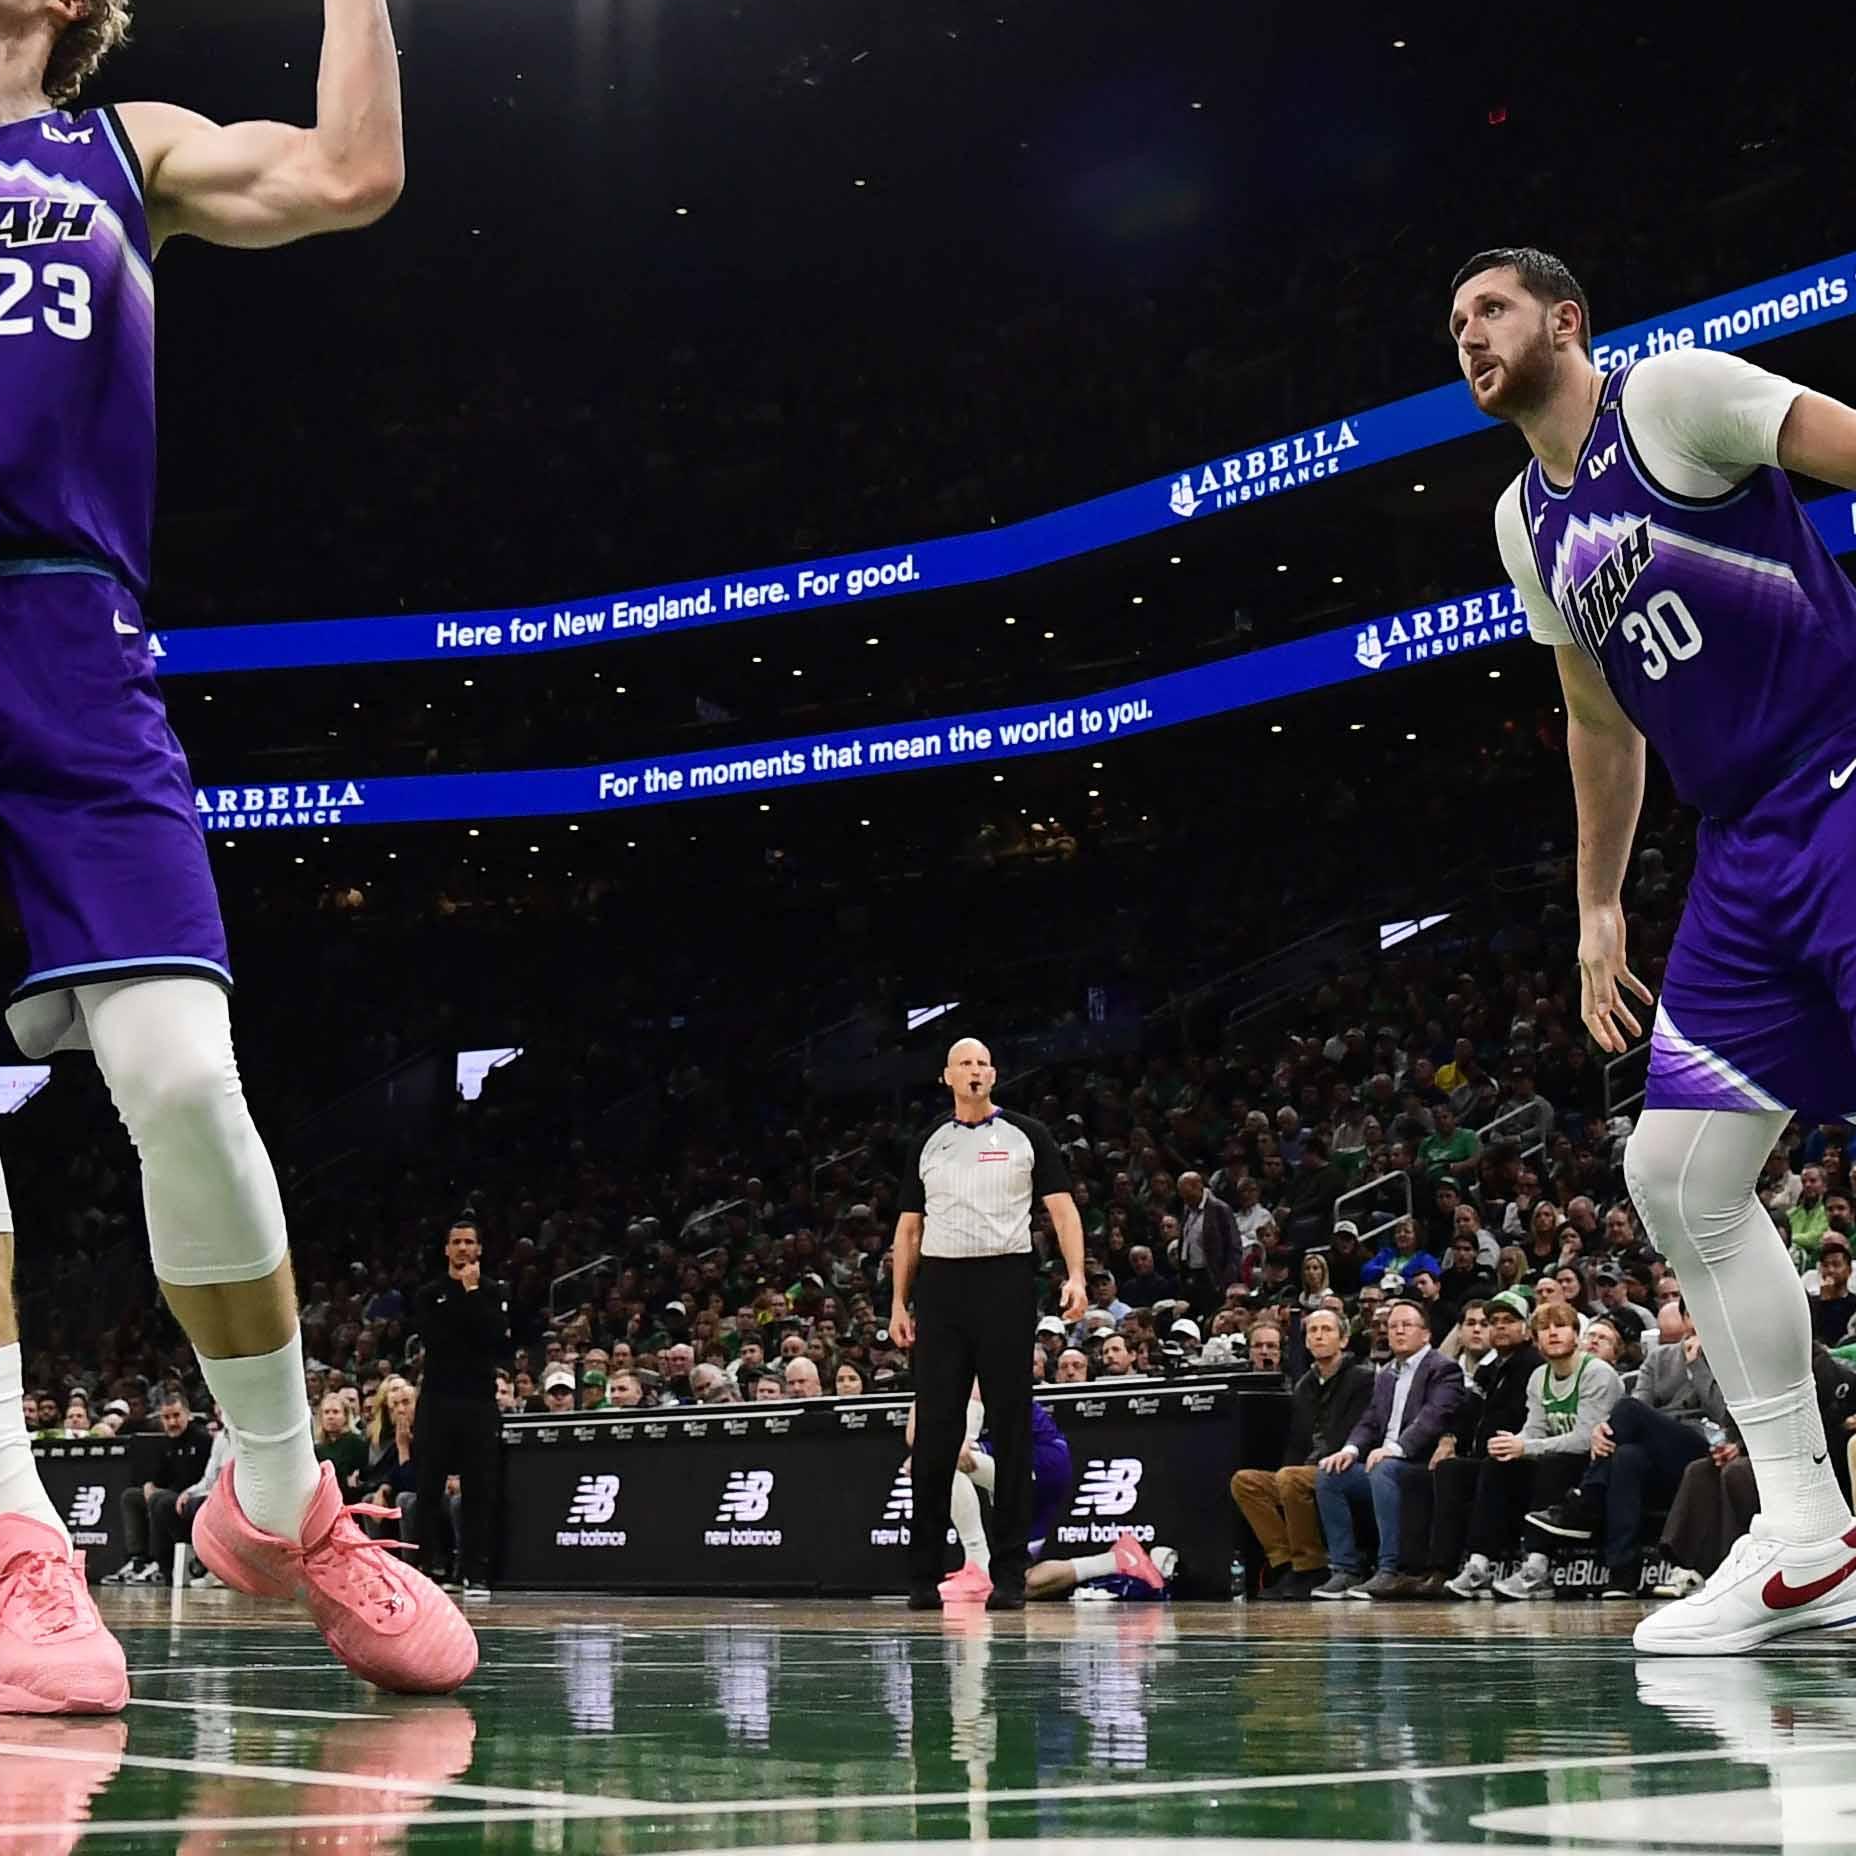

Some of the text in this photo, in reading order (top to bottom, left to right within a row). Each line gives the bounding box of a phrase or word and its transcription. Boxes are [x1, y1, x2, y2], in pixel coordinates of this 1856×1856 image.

[1593, 343, 1639, 376] For
[1646, 320, 1696, 356] the
[1702, 277, 1848, 343] moments
[1196, 419, 1359, 496] ARBELLA
[1588, 441, 1618, 480] LVT
[1216, 456, 1340, 509] INSURANCE
[436, 553, 921, 648] Here for New England. Here. For good.
[1623, 589, 1703, 681] 30
[598, 698, 1154, 799] For the moments that mean the world to you.
[195, 781, 365, 813] ARBELLA
[207, 809, 342, 830] INSURANCE
[556, 1530, 627, 1546] new balance
[705, 1527, 783, 1546] new balance
[871, 1528, 897, 1545] new
[1057, 1526, 1089, 1543] new
